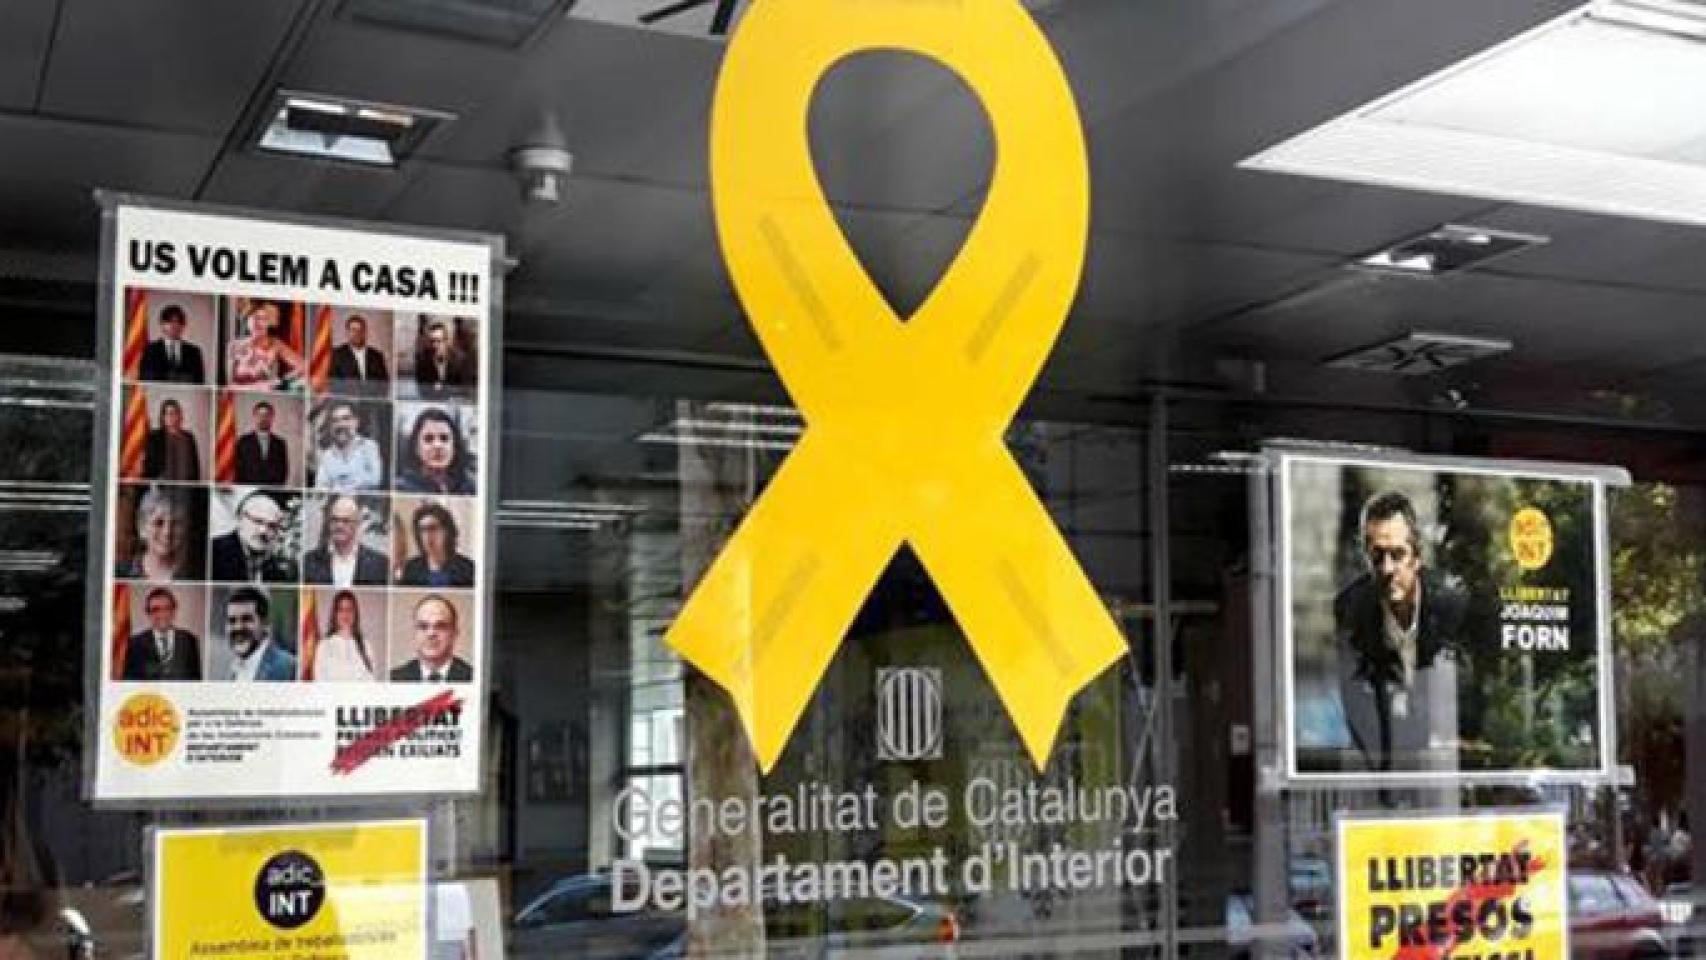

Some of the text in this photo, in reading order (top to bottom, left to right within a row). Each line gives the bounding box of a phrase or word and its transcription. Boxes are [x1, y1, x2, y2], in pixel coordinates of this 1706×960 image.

[129, 240, 480, 303] US VOLEM A CASA !!!
[1502, 624, 1570, 651] FORN
[126, 734, 168, 755] INT
[613, 777, 1178, 842] Generalitat de Catalunya
[611, 839, 1173, 918] Departament d'Interior
[1368, 851, 1532, 893] LLIBERTAT
[268, 890, 313, 917] INT
[1369, 897, 1534, 949] PRESOS
